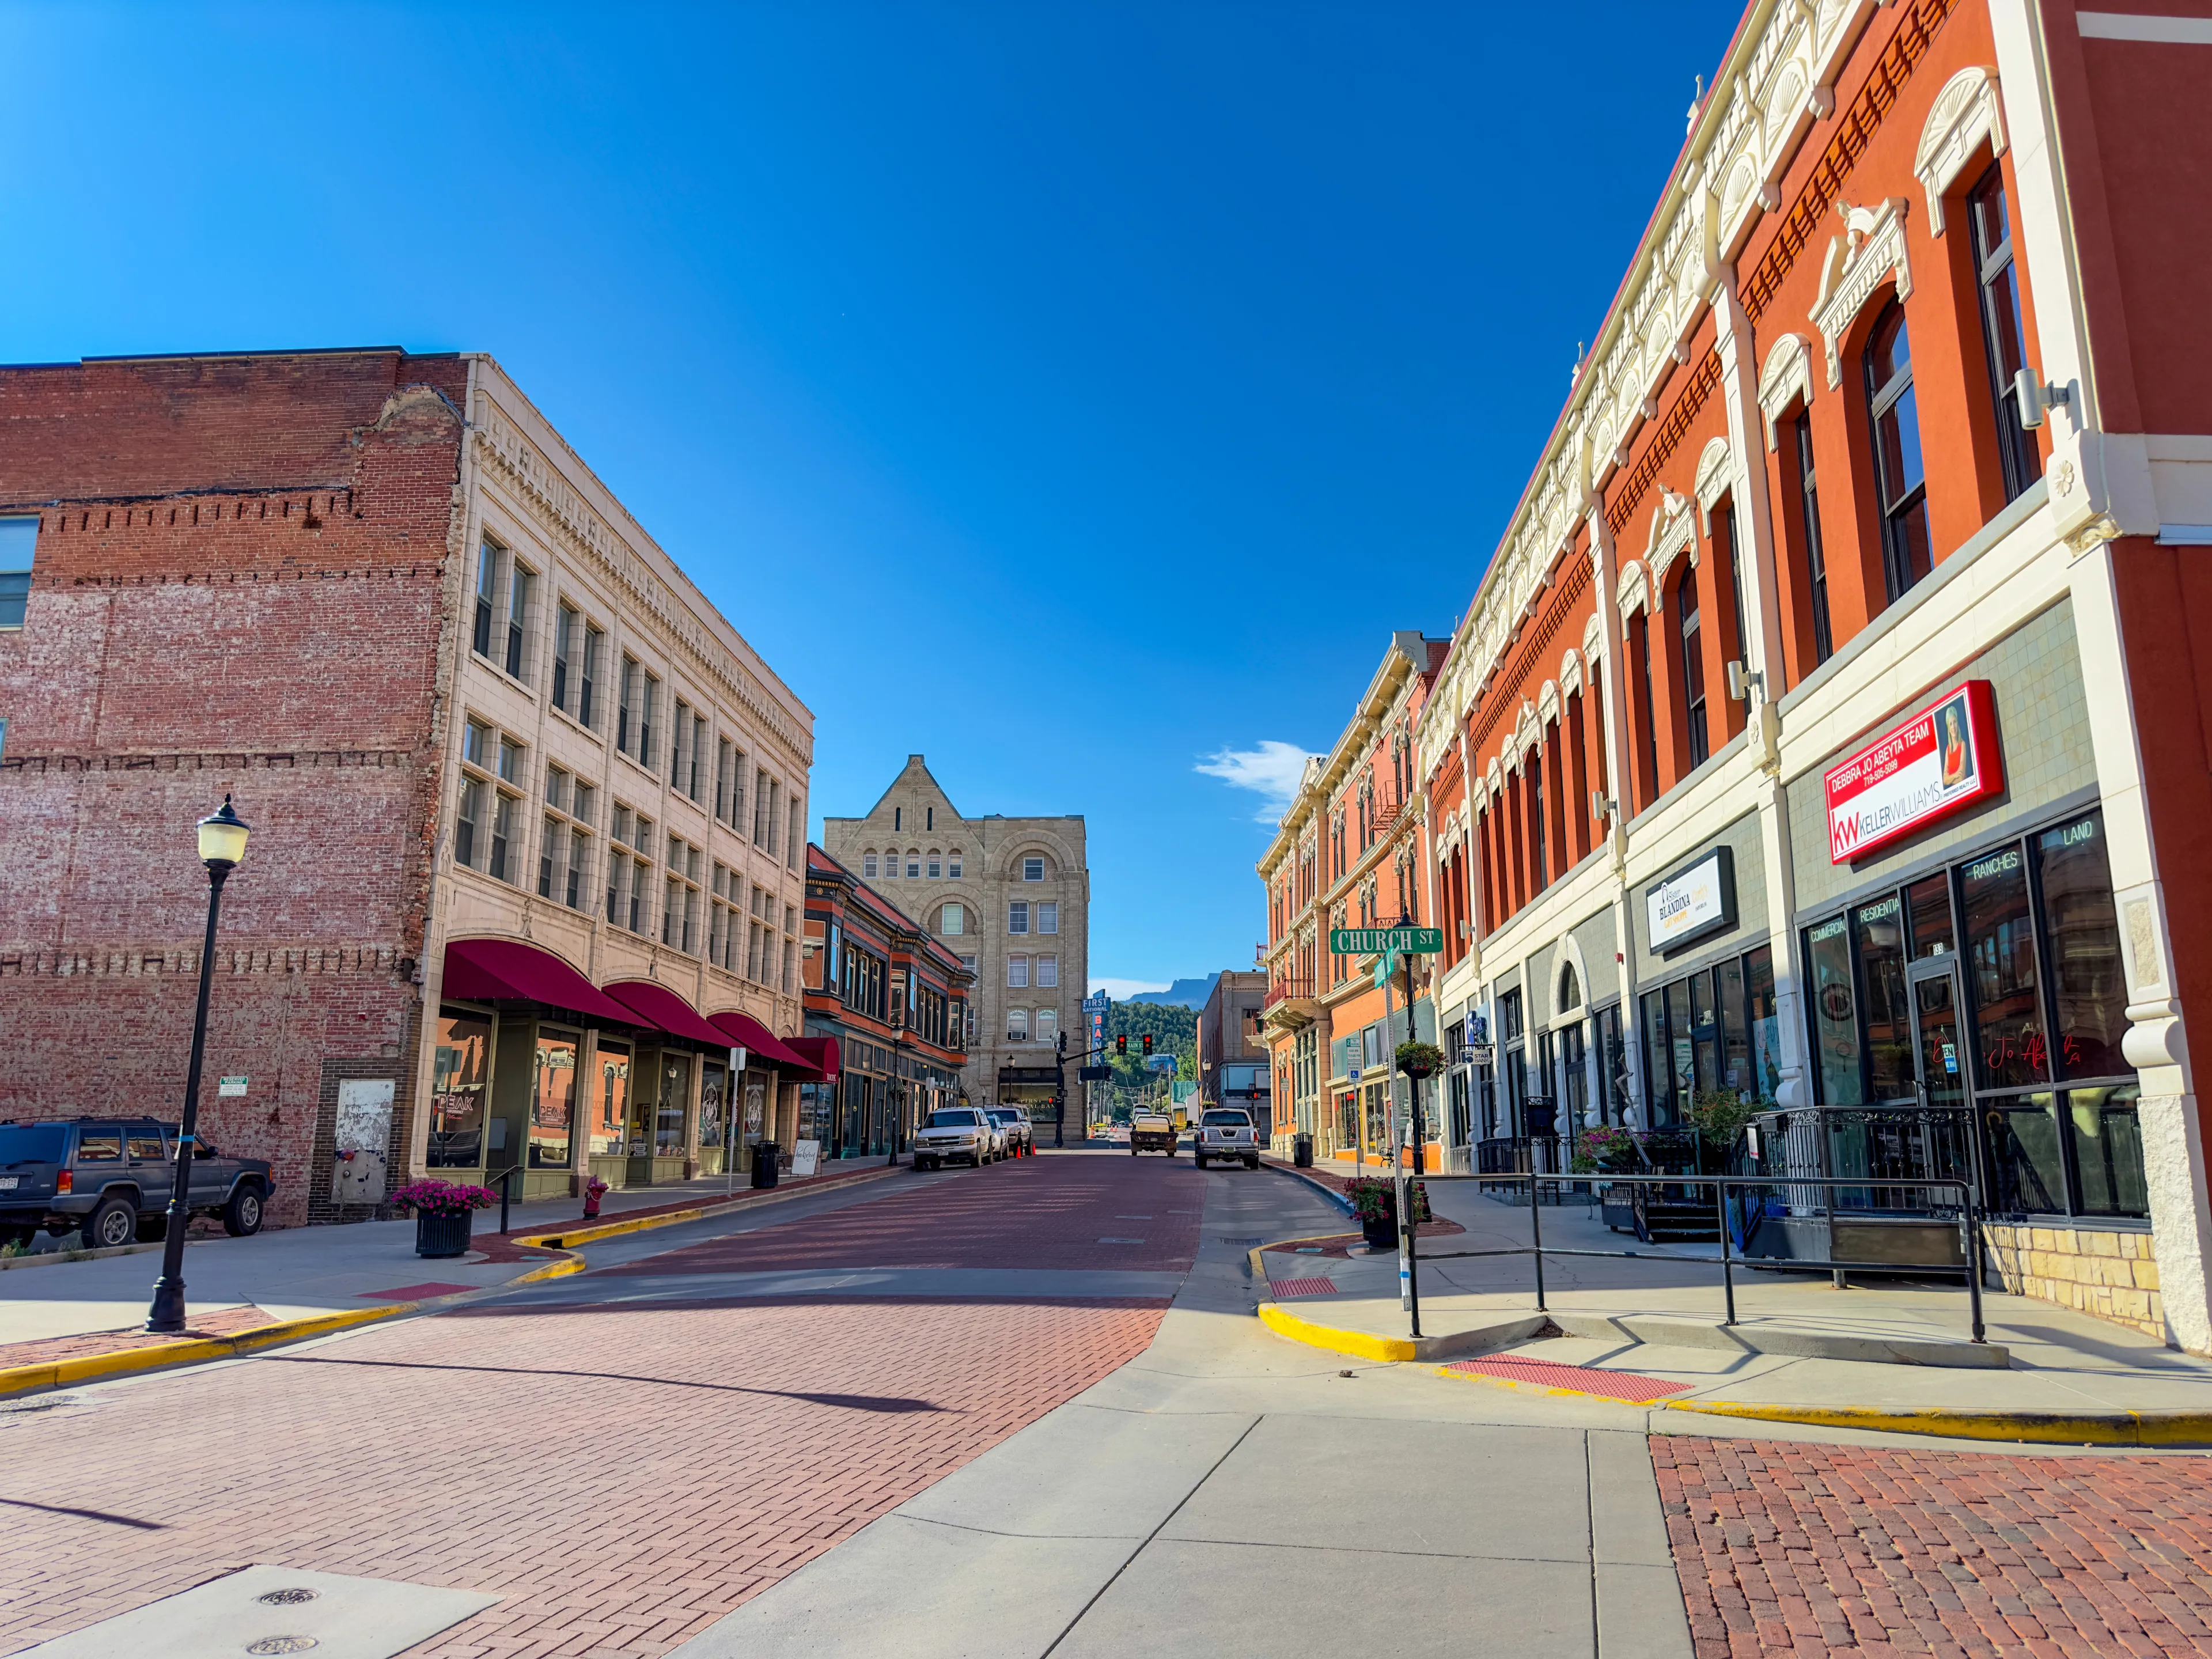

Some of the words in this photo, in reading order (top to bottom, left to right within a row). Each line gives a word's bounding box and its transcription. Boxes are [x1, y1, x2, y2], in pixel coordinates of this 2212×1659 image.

[1832, 765, 1861, 793] DEBBRA
[1862, 757, 1872, 774] JO
[1874, 738, 1903, 768] ABEYTA
[1904, 721, 1929, 748] TEAM
[1863, 759, 1898, 787] 719-505-5099
[1944, 787, 1959, 798] PREFERRED
[1959, 781, 1969, 790] REALTY
[2063, 821, 2093, 845] LAND
[1973, 851, 2017, 880] RANCHES
[1668, 889, 1681, 902] Sister
[1659, 893, 1690, 921] BLANDINA
[1860, 897, 1899, 922] RESIDENTIA
[1811, 919, 1846, 942] COMMERCIAL
[1338, 930, 1412, 951] CHURCH
[1419, 930, 1434, 944] ST
[1934, 944, 1942, 955] 133
[1083, 998, 1108, 1007] FIRST
[1465, 1051, 1474, 1063] 5
[438, 1094, 474, 1111] PEAK
[539, 1105, 567, 1119] PEAK
[796, 1145, 816, 1161] bakery
